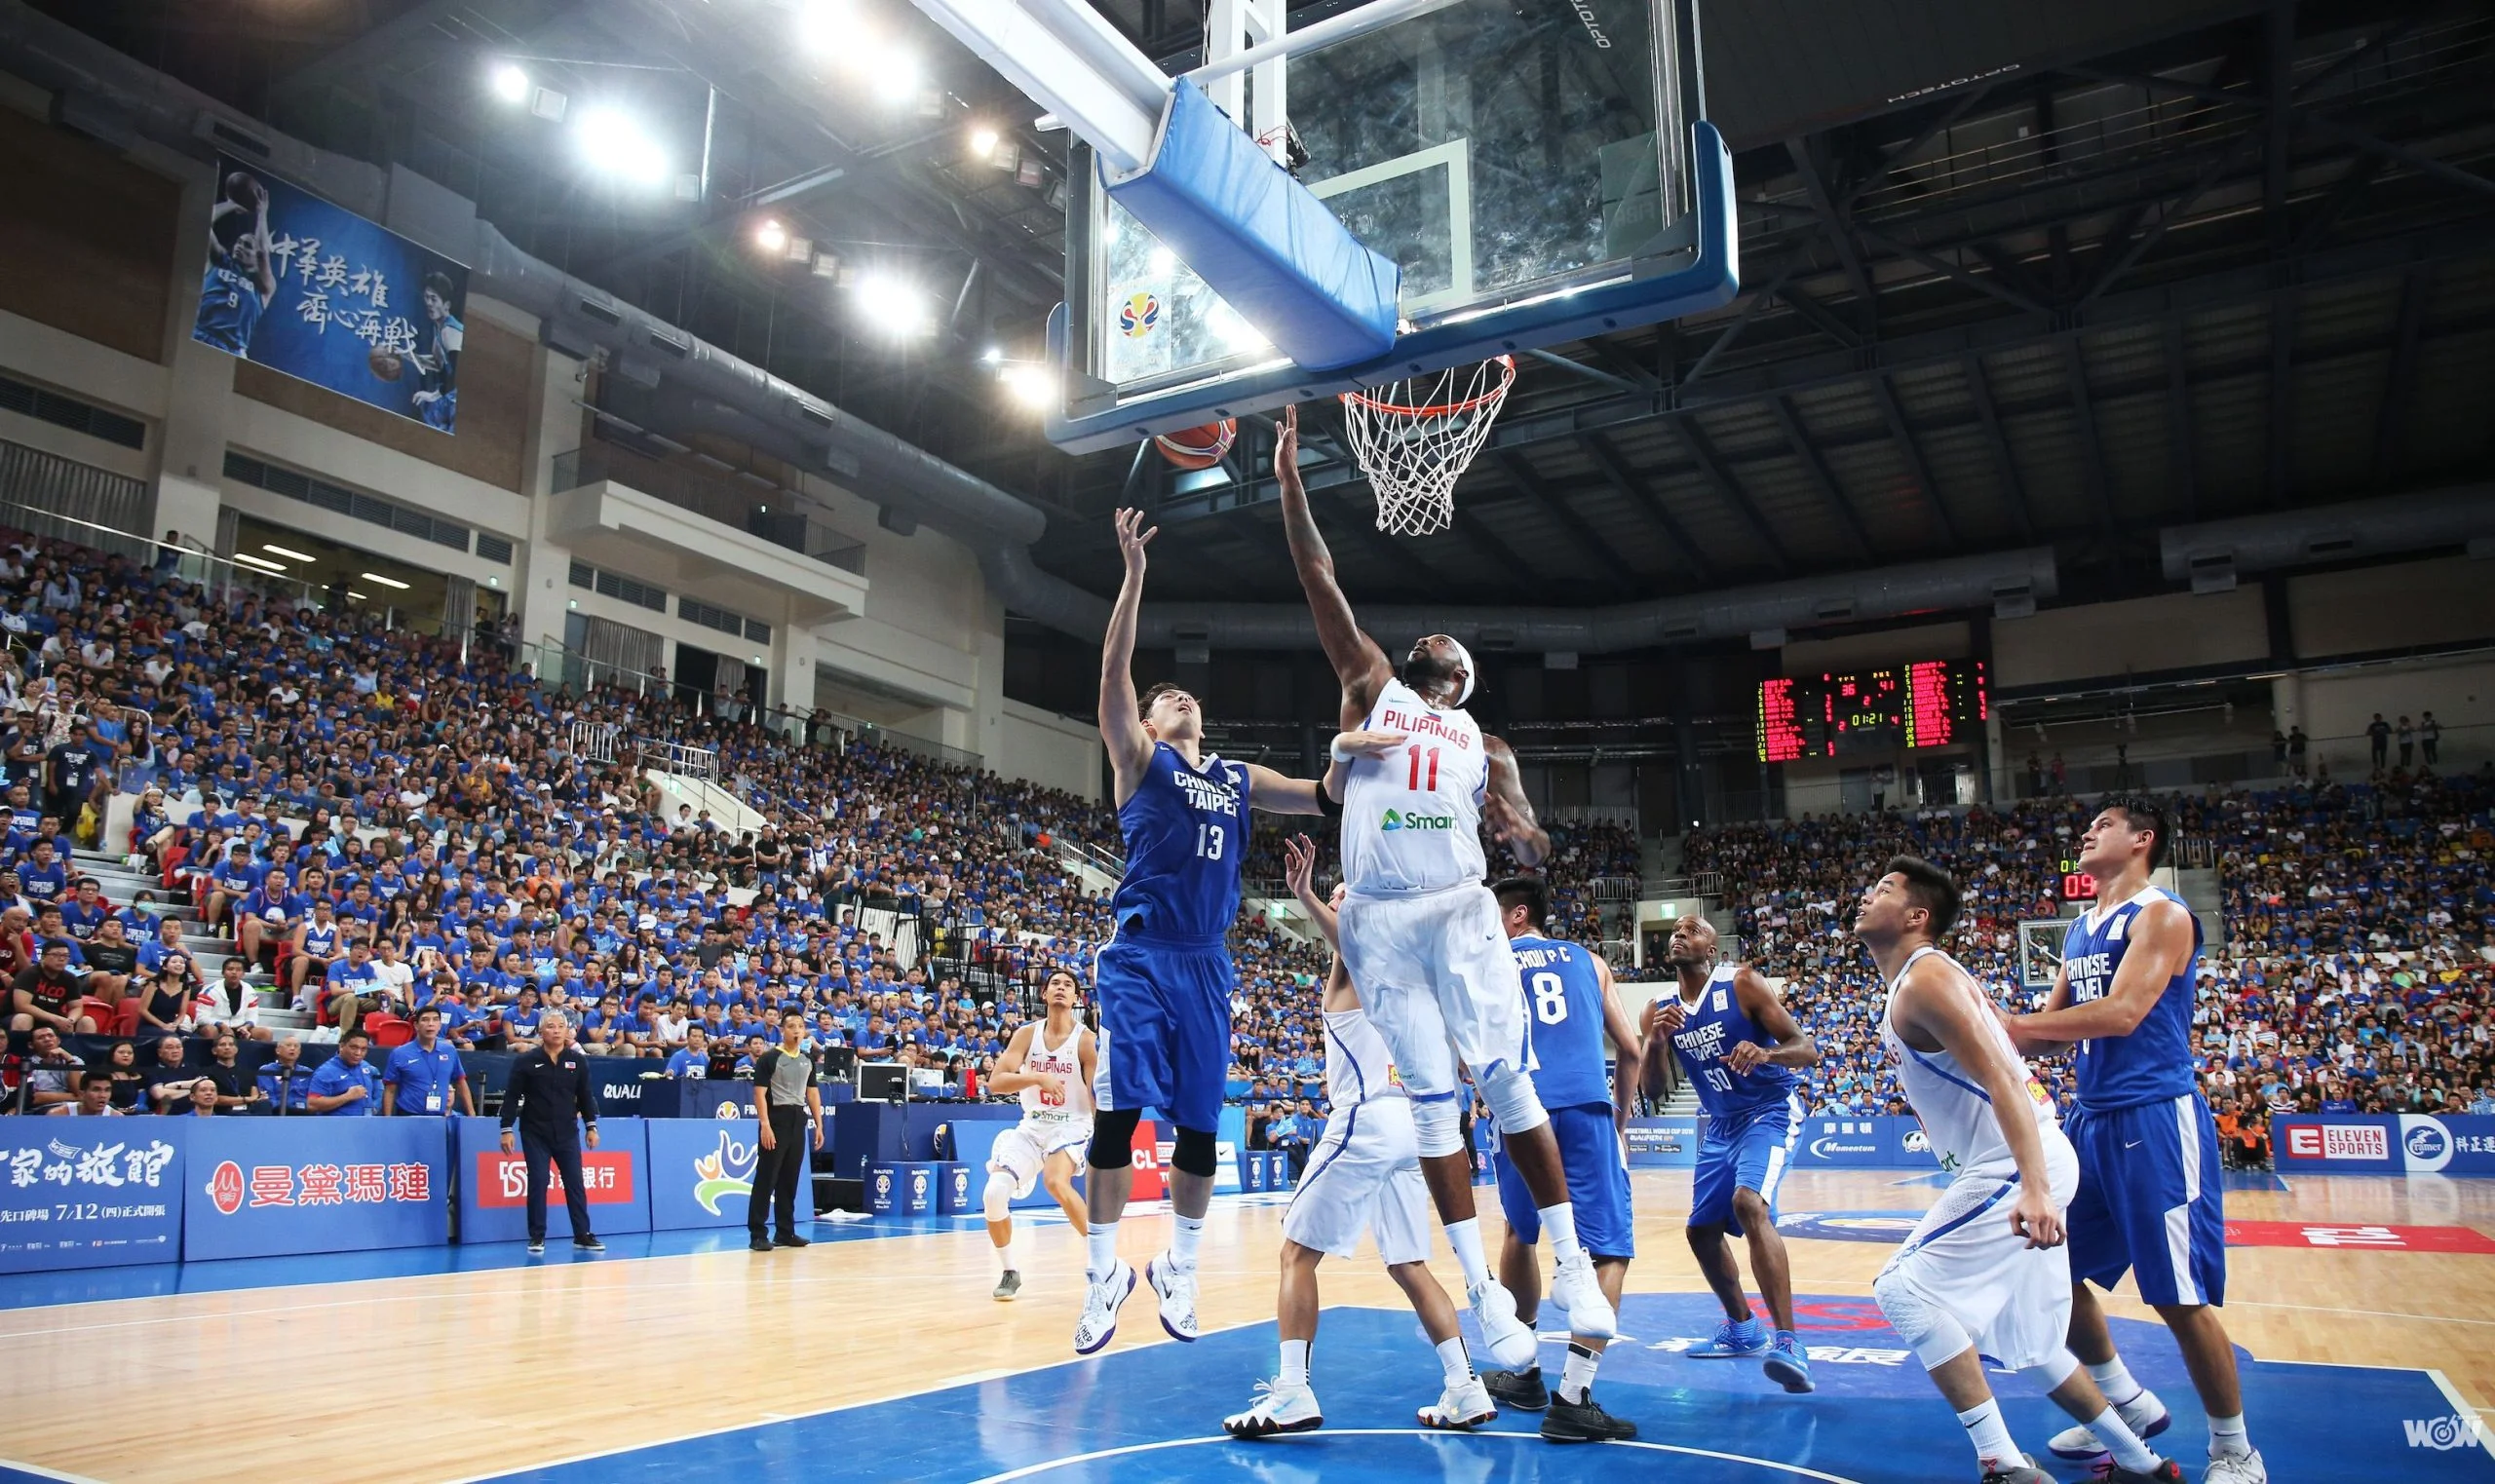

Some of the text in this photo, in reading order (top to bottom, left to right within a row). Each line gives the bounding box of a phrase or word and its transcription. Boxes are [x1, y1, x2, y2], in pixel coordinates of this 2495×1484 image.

[270, 230, 389, 309] 中華英雄
[1842, 684, 1856, 697] 36
[1879, 680, 1895, 691] 41
[1852, 712, 1883, 726] 01:21
[1384, 709, 1470, 750] PILIPINAS
[1408, 744, 1439, 791] 11
[1404, 813, 1458, 830] Smar
[1197, 823, 1224, 860] 13
[1532, 972, 1568, 1025] 8
[1031, 1060, 1073, 1074] PILIPINAS
[1703, 1067, 1733, 1092] 50
[603, 1084, 642, 1099] QUALI
[1042, 1110, 1070, 1122] Smart
[2328, 1129, 2382, 1143] ELEVEN
[1823, 1142, 1876, 1152] Momentum
[2329, 1143, 2383, 1155] SPORTS
[0, 1139, 174, 1188] 家的旅館
[250, 1161, 431, 1206] 曼黛瑪璉
[56, 1202, 98, 1221] 7/12
